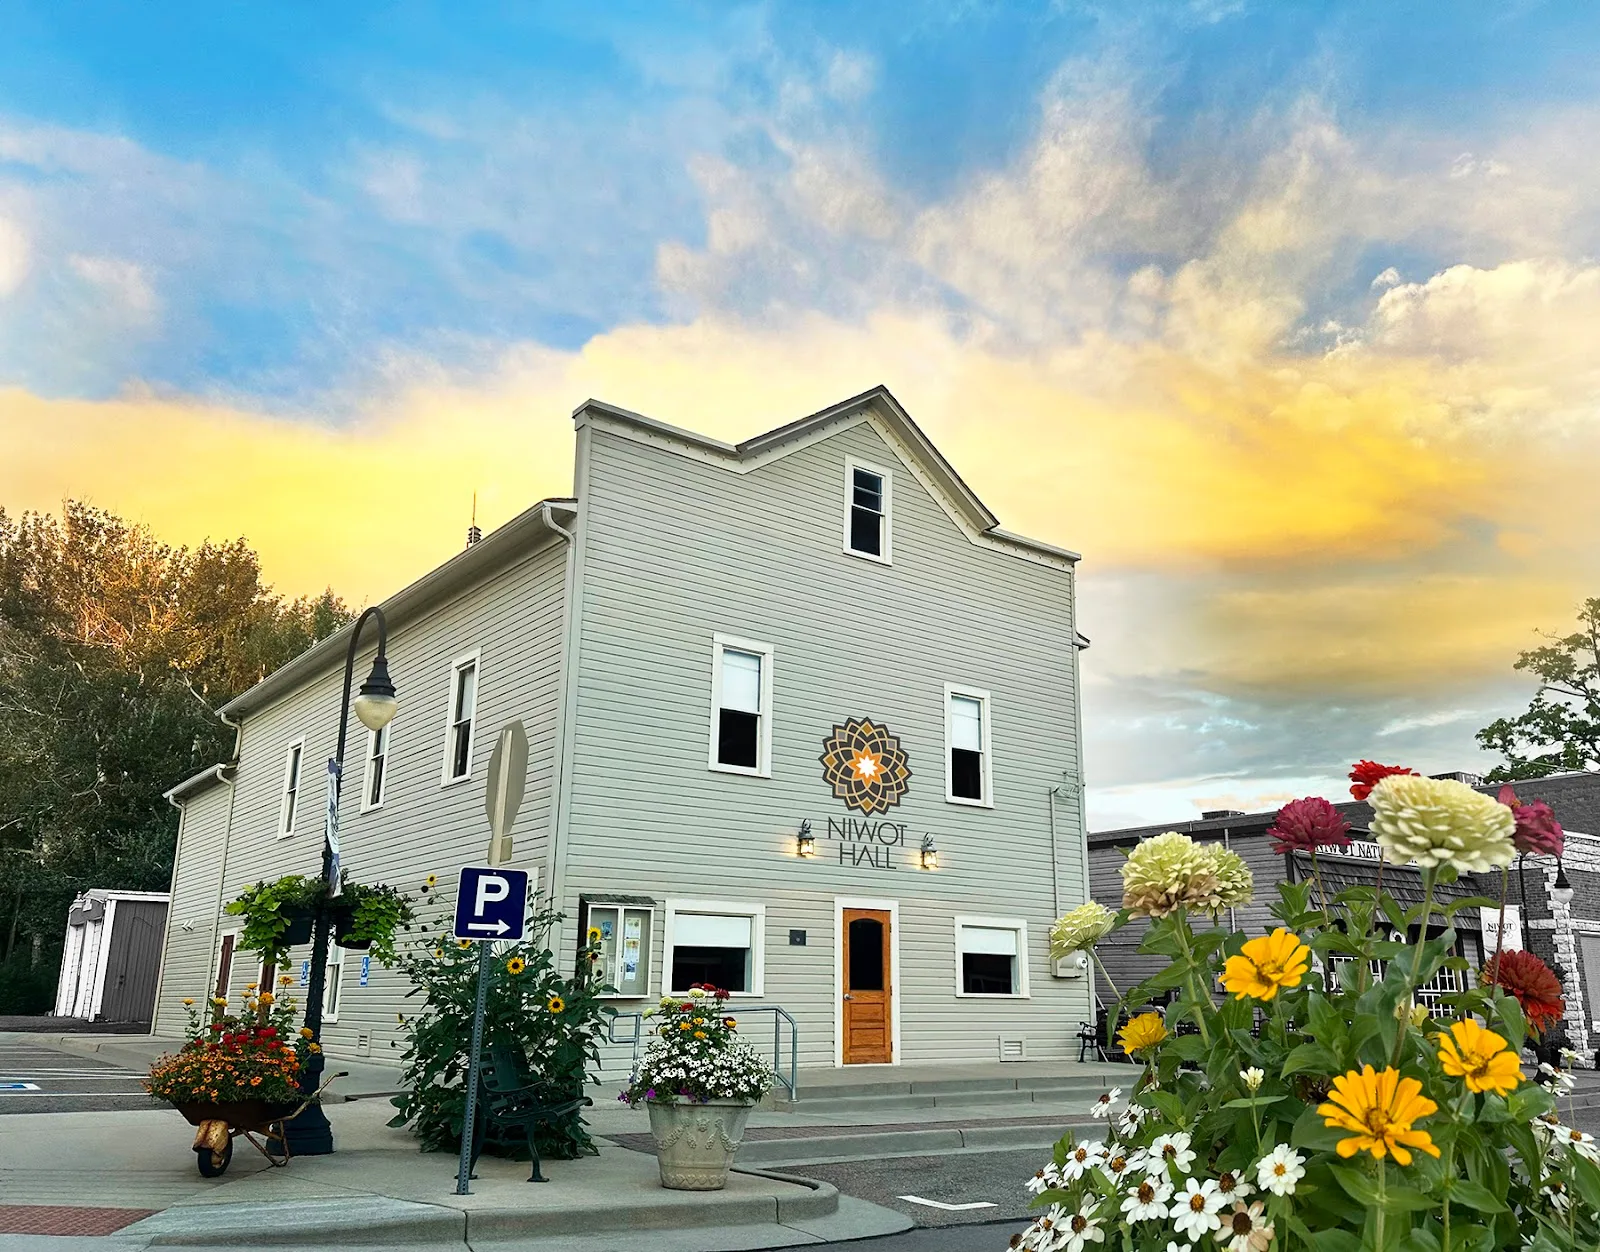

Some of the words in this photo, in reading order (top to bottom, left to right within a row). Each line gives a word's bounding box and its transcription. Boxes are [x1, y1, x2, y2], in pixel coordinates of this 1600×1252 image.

[828, 816, 908, 846] NIWOT
[840, 842, 897, 870] HALL
[1358, 843, 1382, 858] NAT
[474, 875, 510, 917] P
